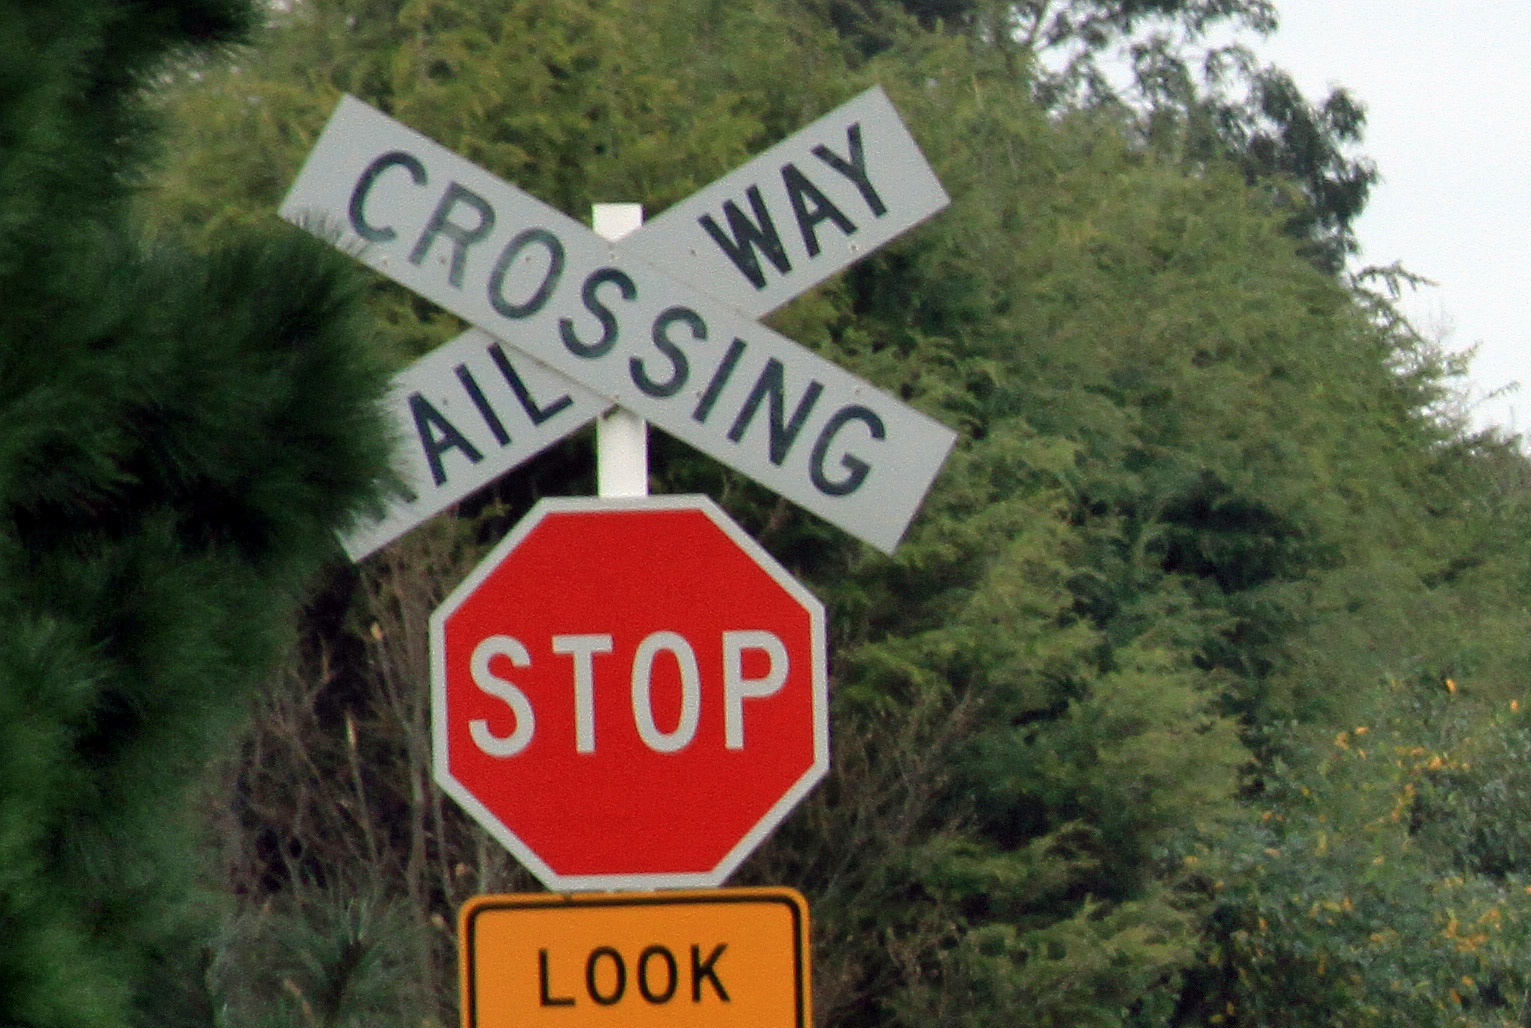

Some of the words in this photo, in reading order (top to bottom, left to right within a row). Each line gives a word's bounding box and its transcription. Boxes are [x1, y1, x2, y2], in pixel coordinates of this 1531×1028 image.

[346, 150, 887, 497] CROSSING
[380, 342, 576, 502] AIL
[697, 121, 888, 290] WAY
[467, 629, 790, 759] STOP
[538, 943, 731, 1008] LOOK
